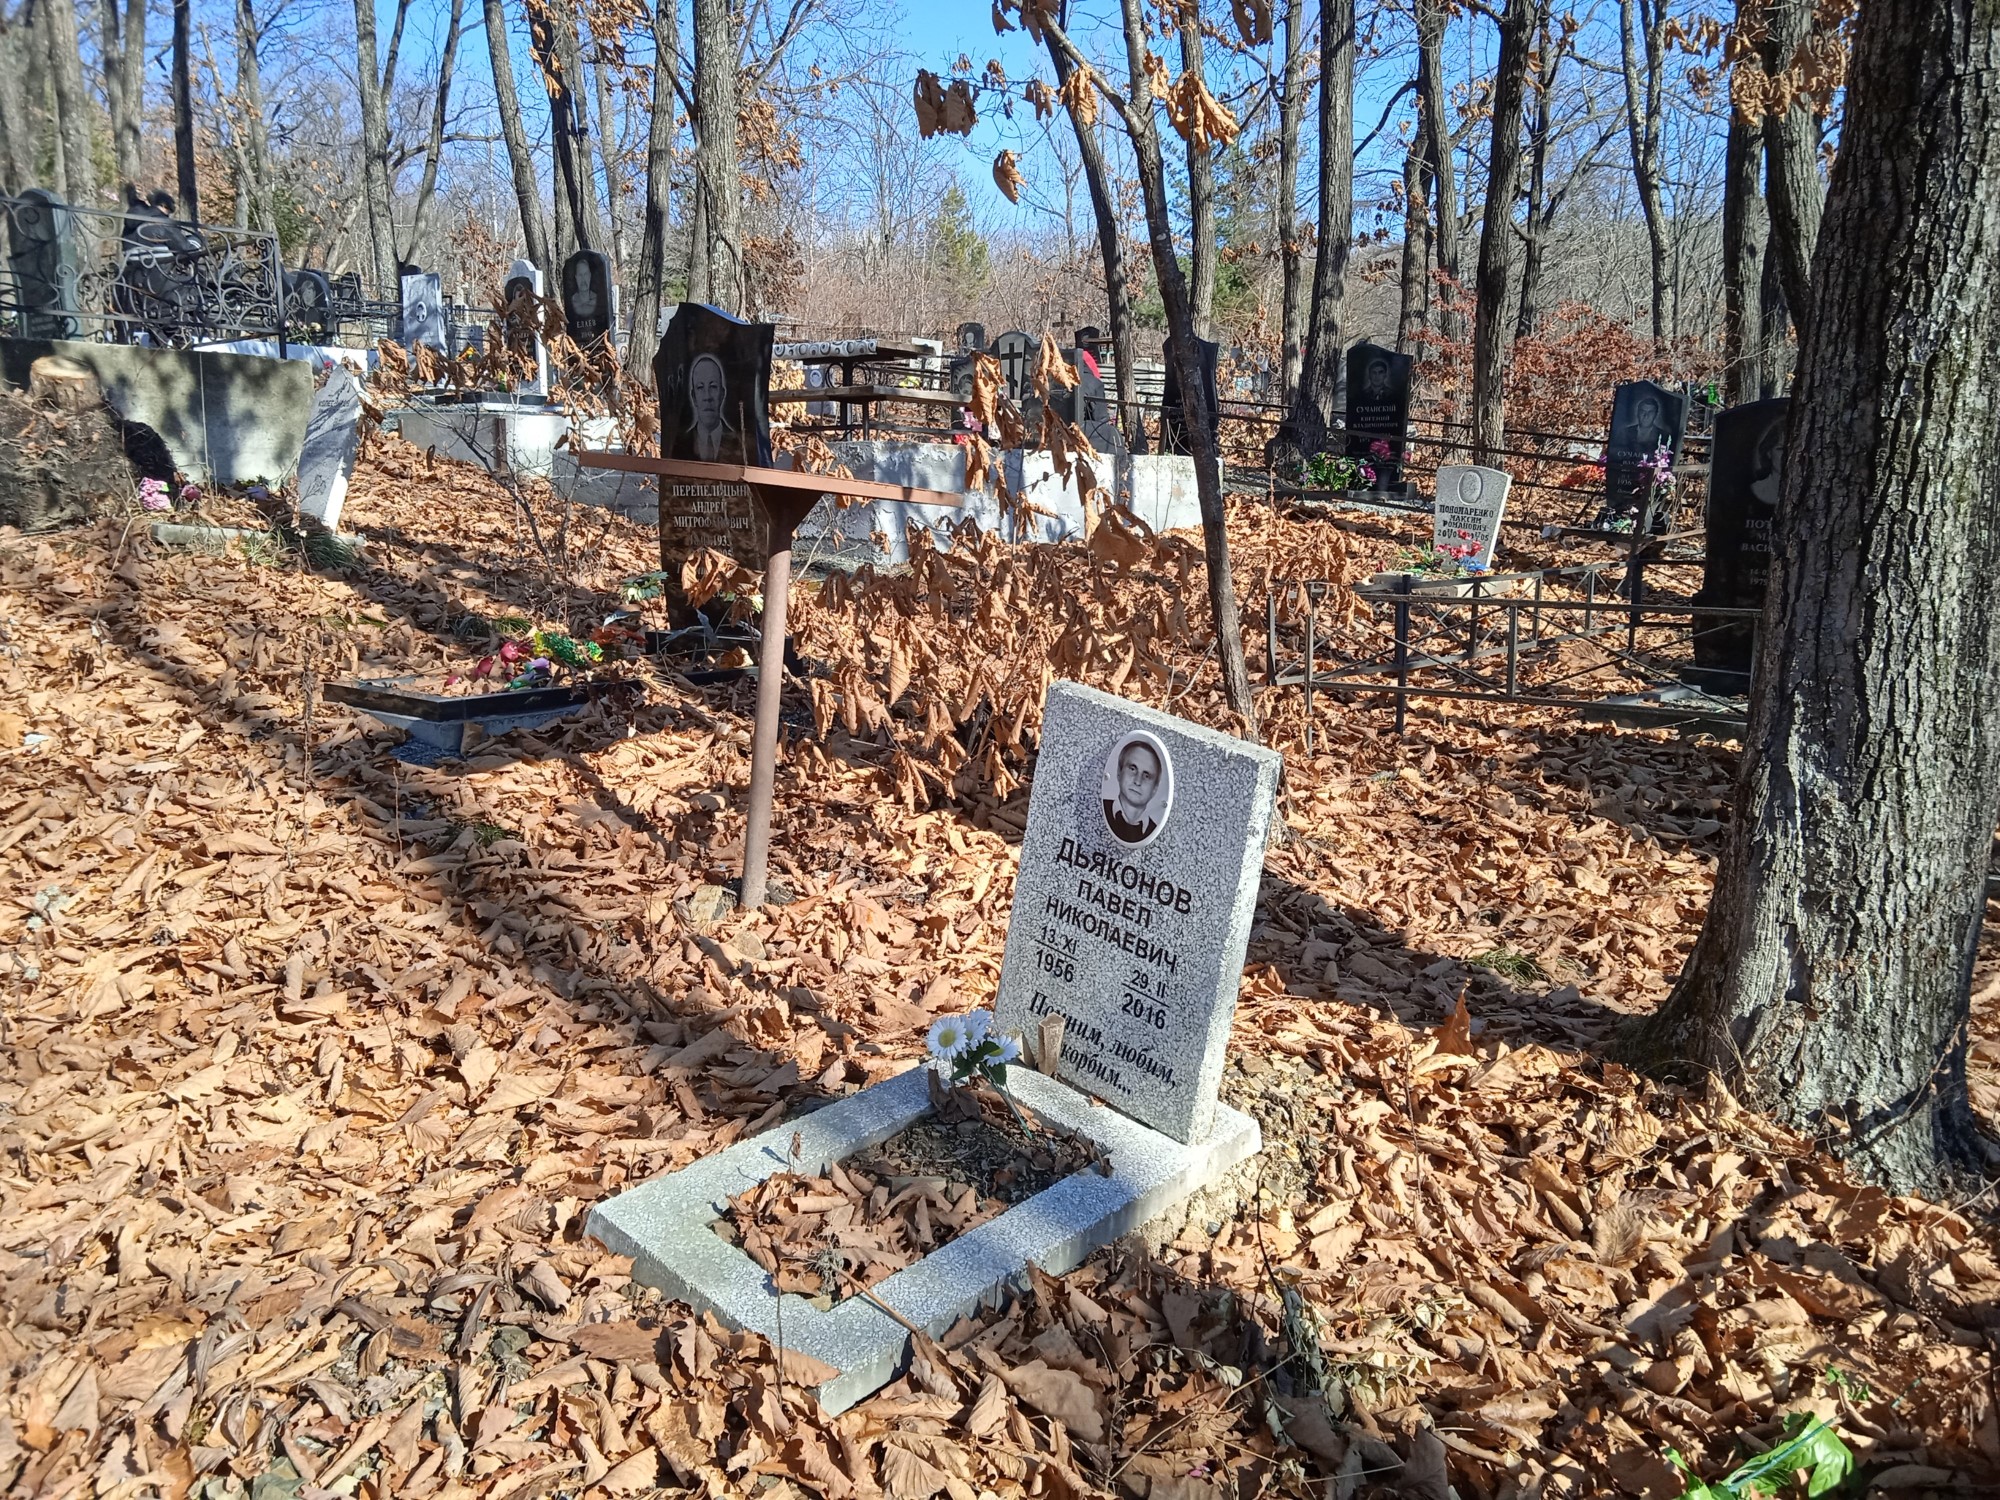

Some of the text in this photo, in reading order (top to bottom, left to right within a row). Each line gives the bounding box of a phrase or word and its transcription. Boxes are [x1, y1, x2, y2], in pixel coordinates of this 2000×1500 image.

[1439, 504, 1494, 518] ПОНОМАРЕНКО
[1442, 519, 1487, 531] РОМАНОВИЧ
[1450, 514, 1483, 525] МАКСИМ
[1057, 837, 1192, 914] ДЬЯКОНОВ
[1077, 879, 1151, 928] ПАВЕЛ
[1045, 895, 1178, 973] НИКОЛАЕВИЧ
[1036, 949, 1075, 983] 1956
[1121, 992, 1167, 1029] 2016
[1060, 1043, 1131, 1095] корбим...
[1109, 1039, 1176, 1089] любим,
